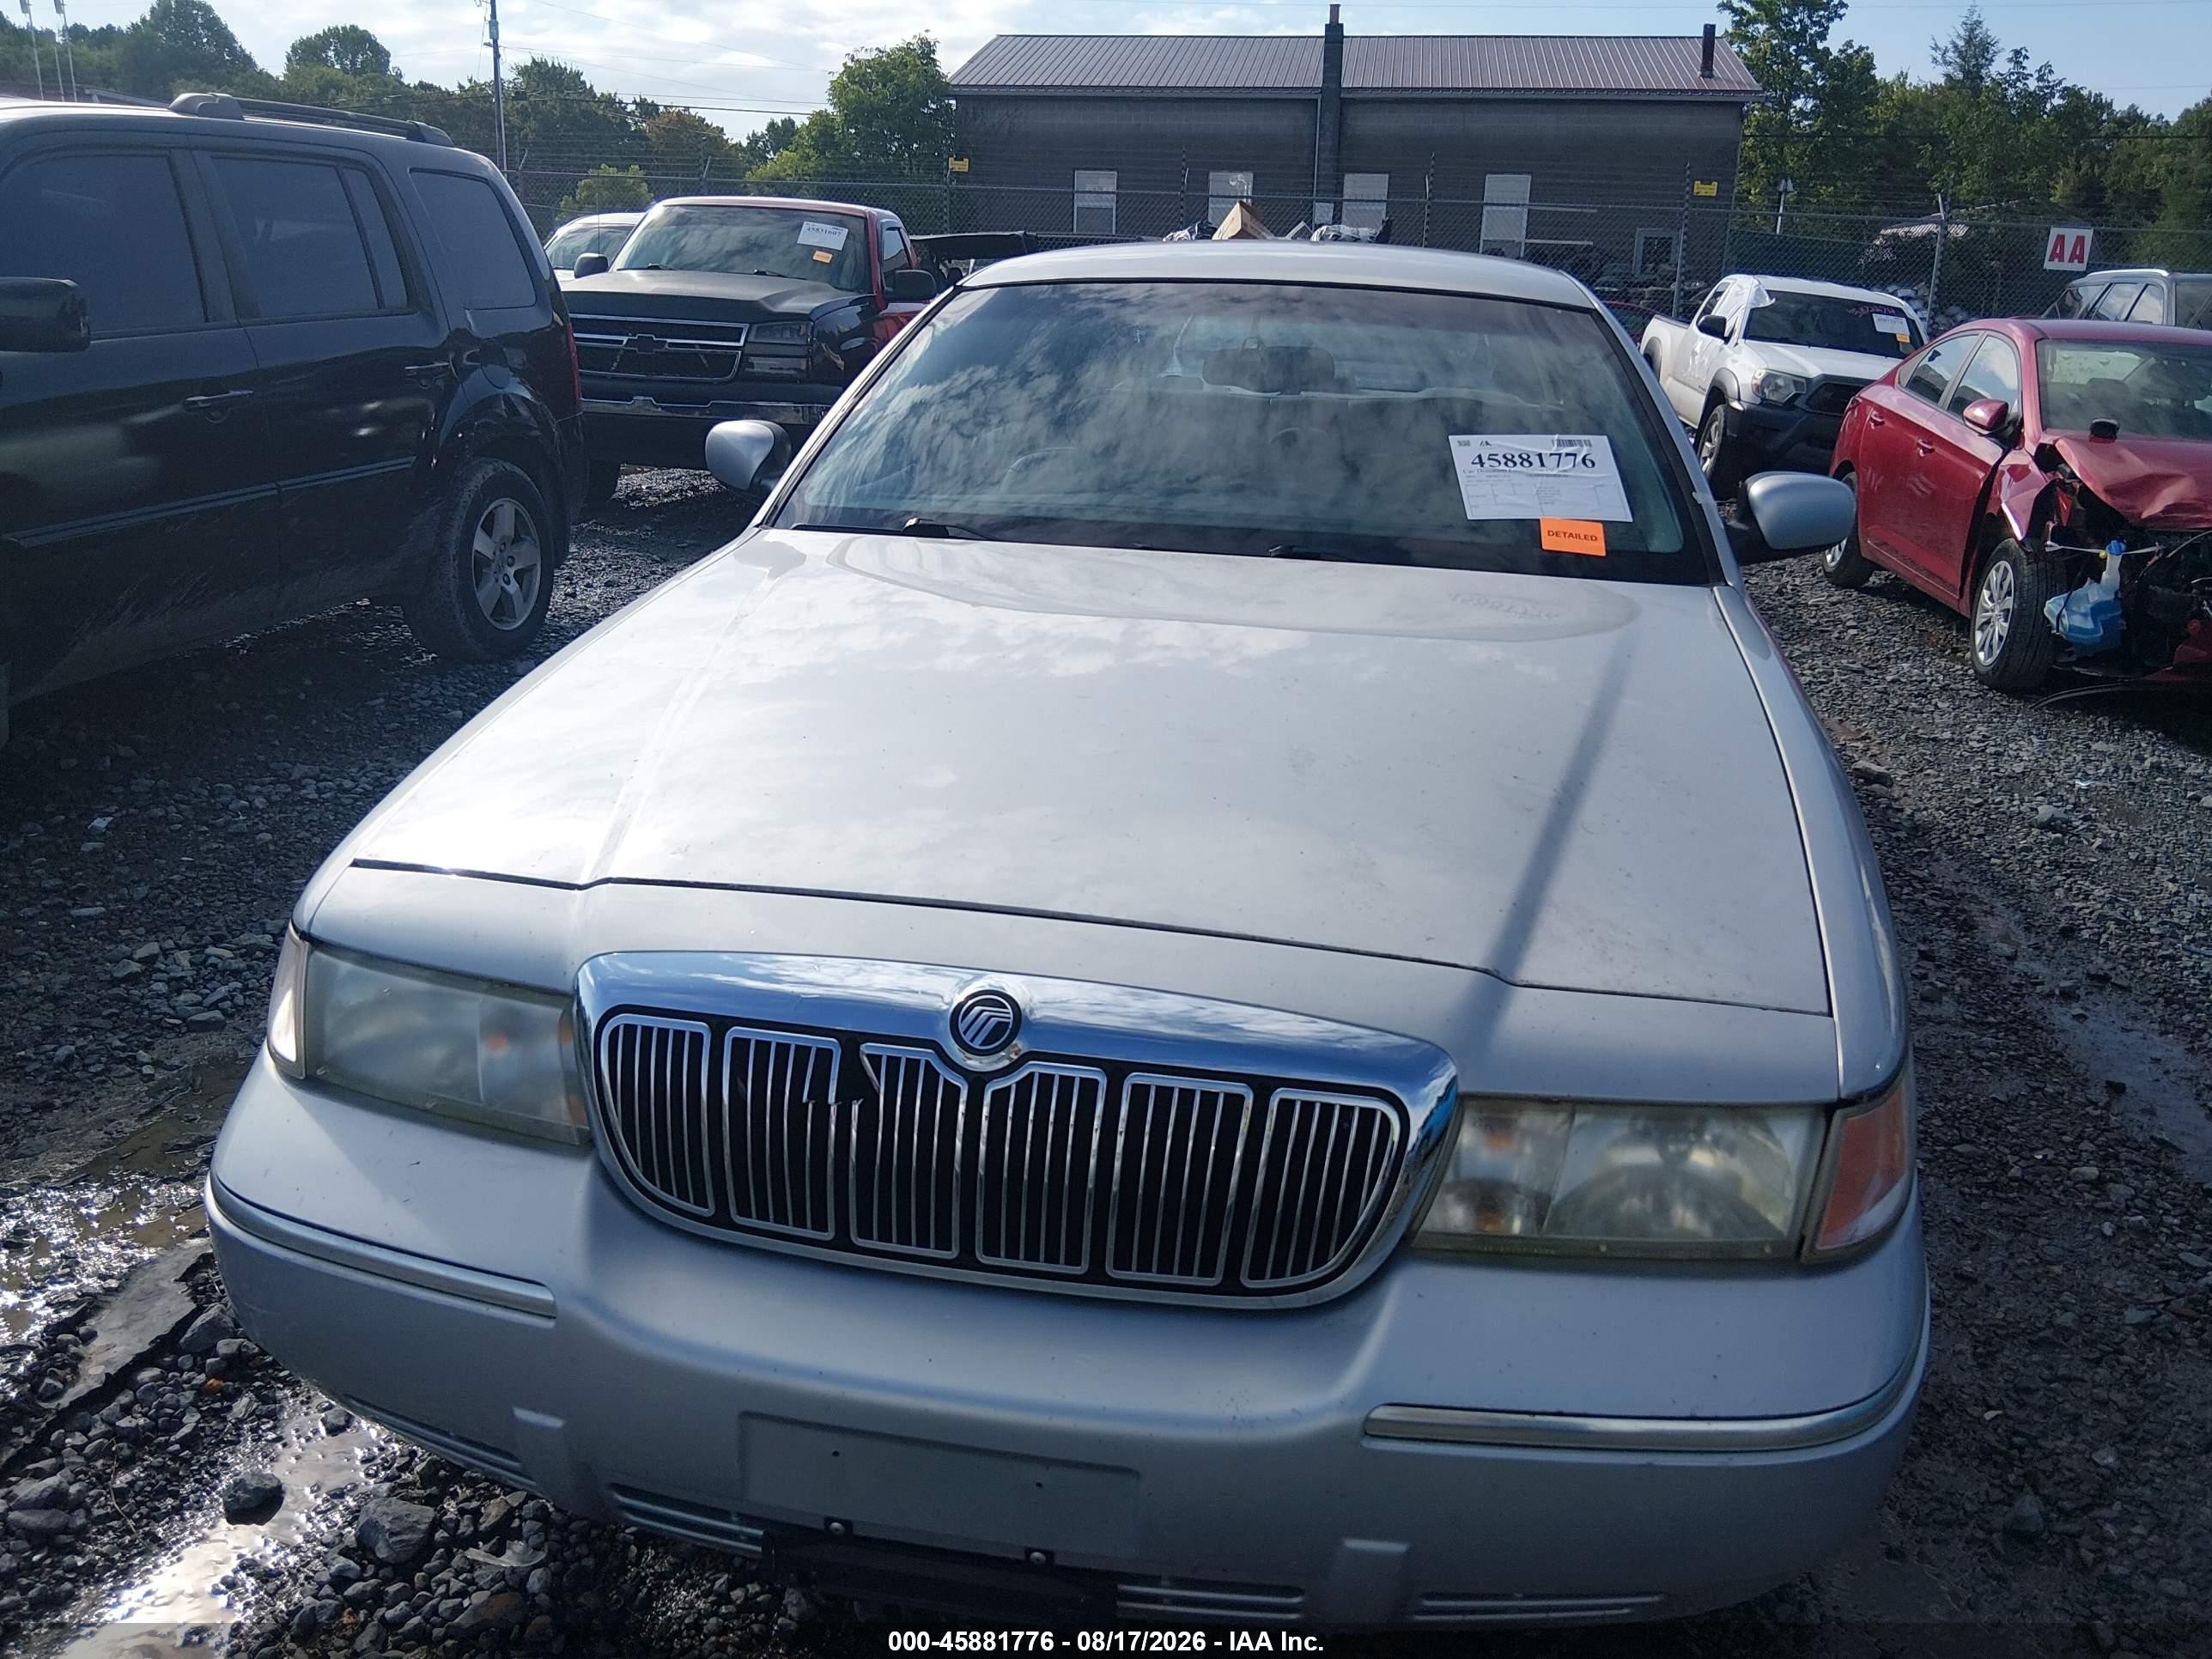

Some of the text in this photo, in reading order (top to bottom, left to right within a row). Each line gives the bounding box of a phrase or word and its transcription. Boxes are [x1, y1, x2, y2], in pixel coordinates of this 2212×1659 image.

[2048, 234, 2085, 264] AA
[1471, 453, 1595, 469] 45881776
[1547, 530, 1598, 542] DETAILED
